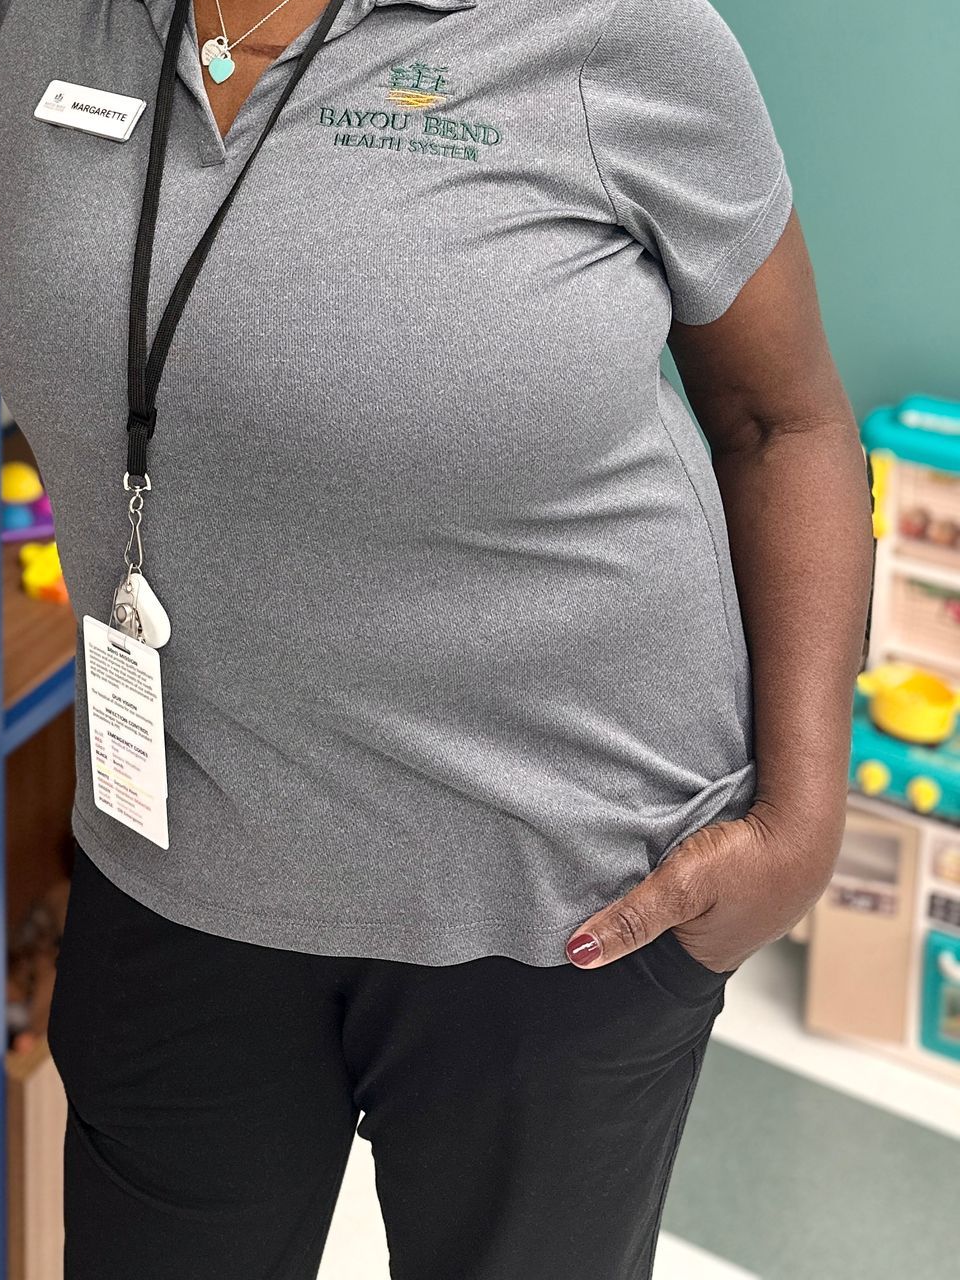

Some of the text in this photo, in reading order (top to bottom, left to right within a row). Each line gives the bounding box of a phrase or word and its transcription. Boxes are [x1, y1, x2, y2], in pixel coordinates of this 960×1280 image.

[71, 101, 128, 122] MARGARETTE
[317, 107, 503, 146] BAYOU BEND
[334, 133, 479, 162] HEALTH SYSTEM
